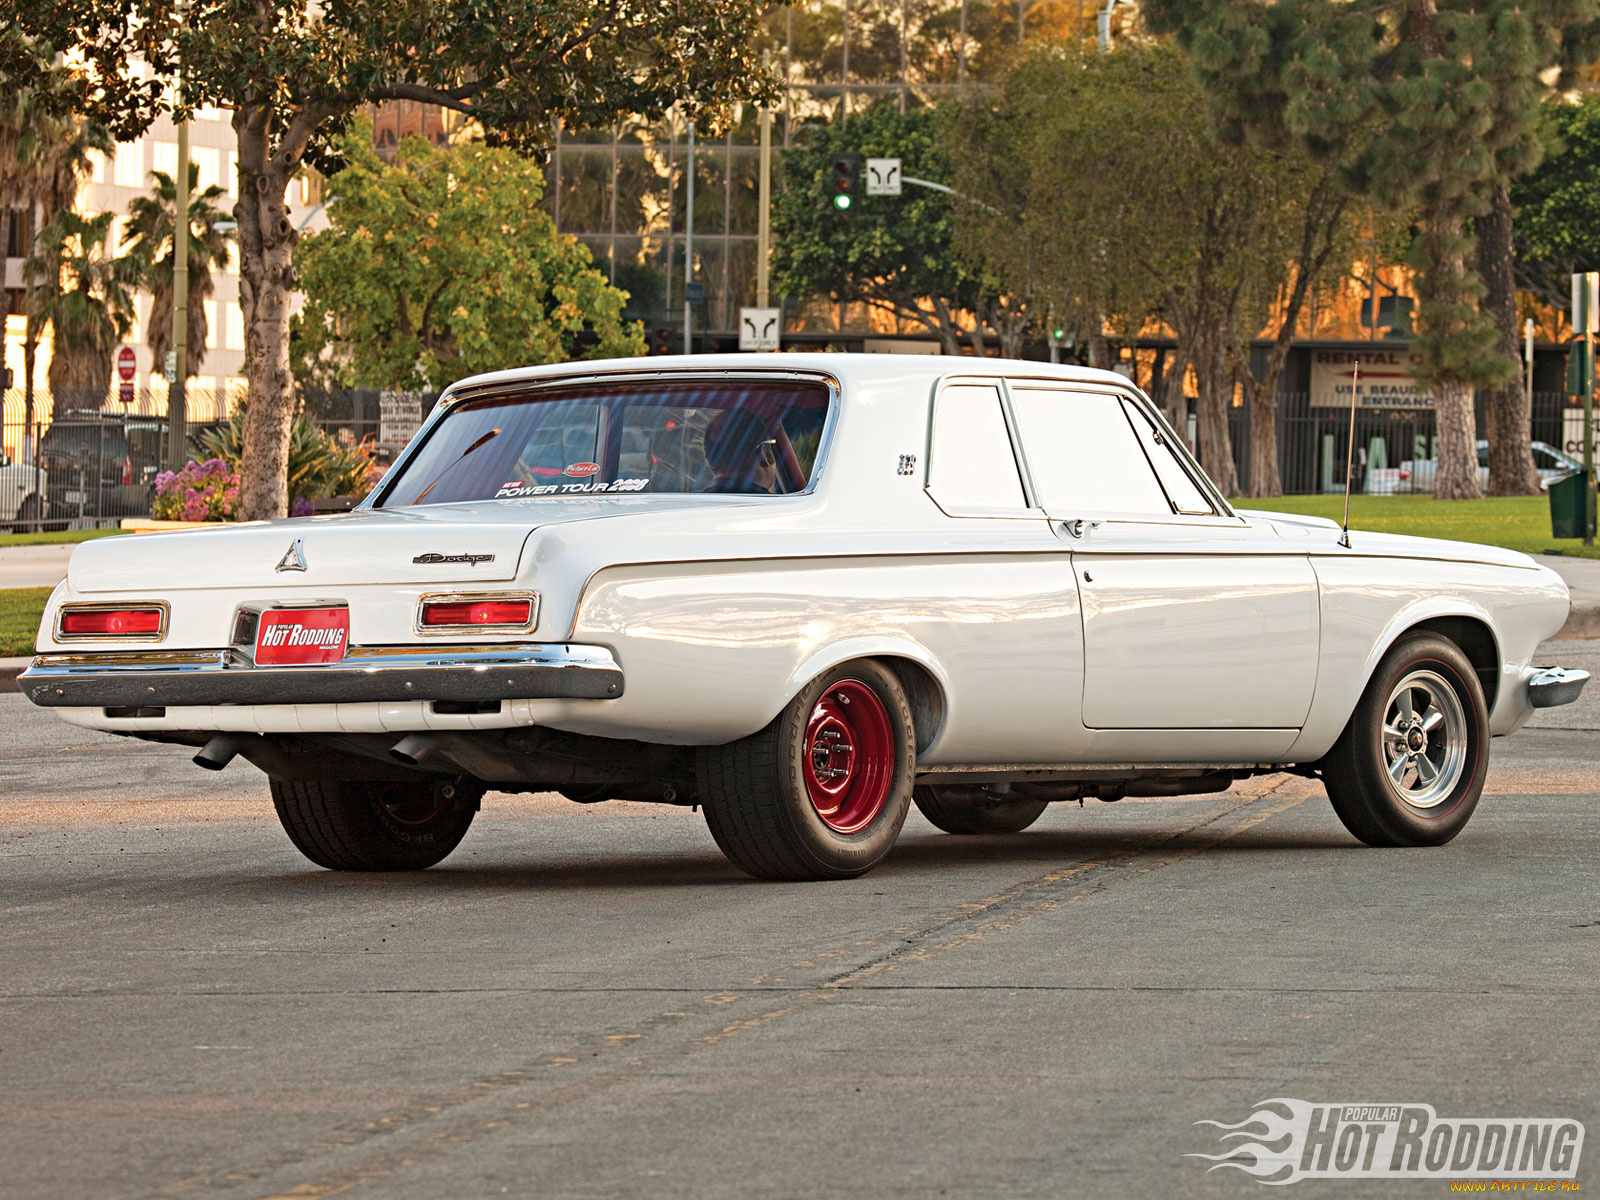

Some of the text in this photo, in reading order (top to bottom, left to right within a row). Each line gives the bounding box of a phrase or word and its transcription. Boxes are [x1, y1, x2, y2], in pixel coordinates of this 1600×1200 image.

[1316, 351, 1400, 365] RENTAL
[1335, 384, 1419, 395] USE BEAUD
[1362, 396, 1435, 406] ENTRANC
[494, 484, 559, 499] POWER
[561, 482, 610, 494] TOUR
[414, 552, 495, 567] Dodge
[261, 624, 345, 647] HOT RODDING
